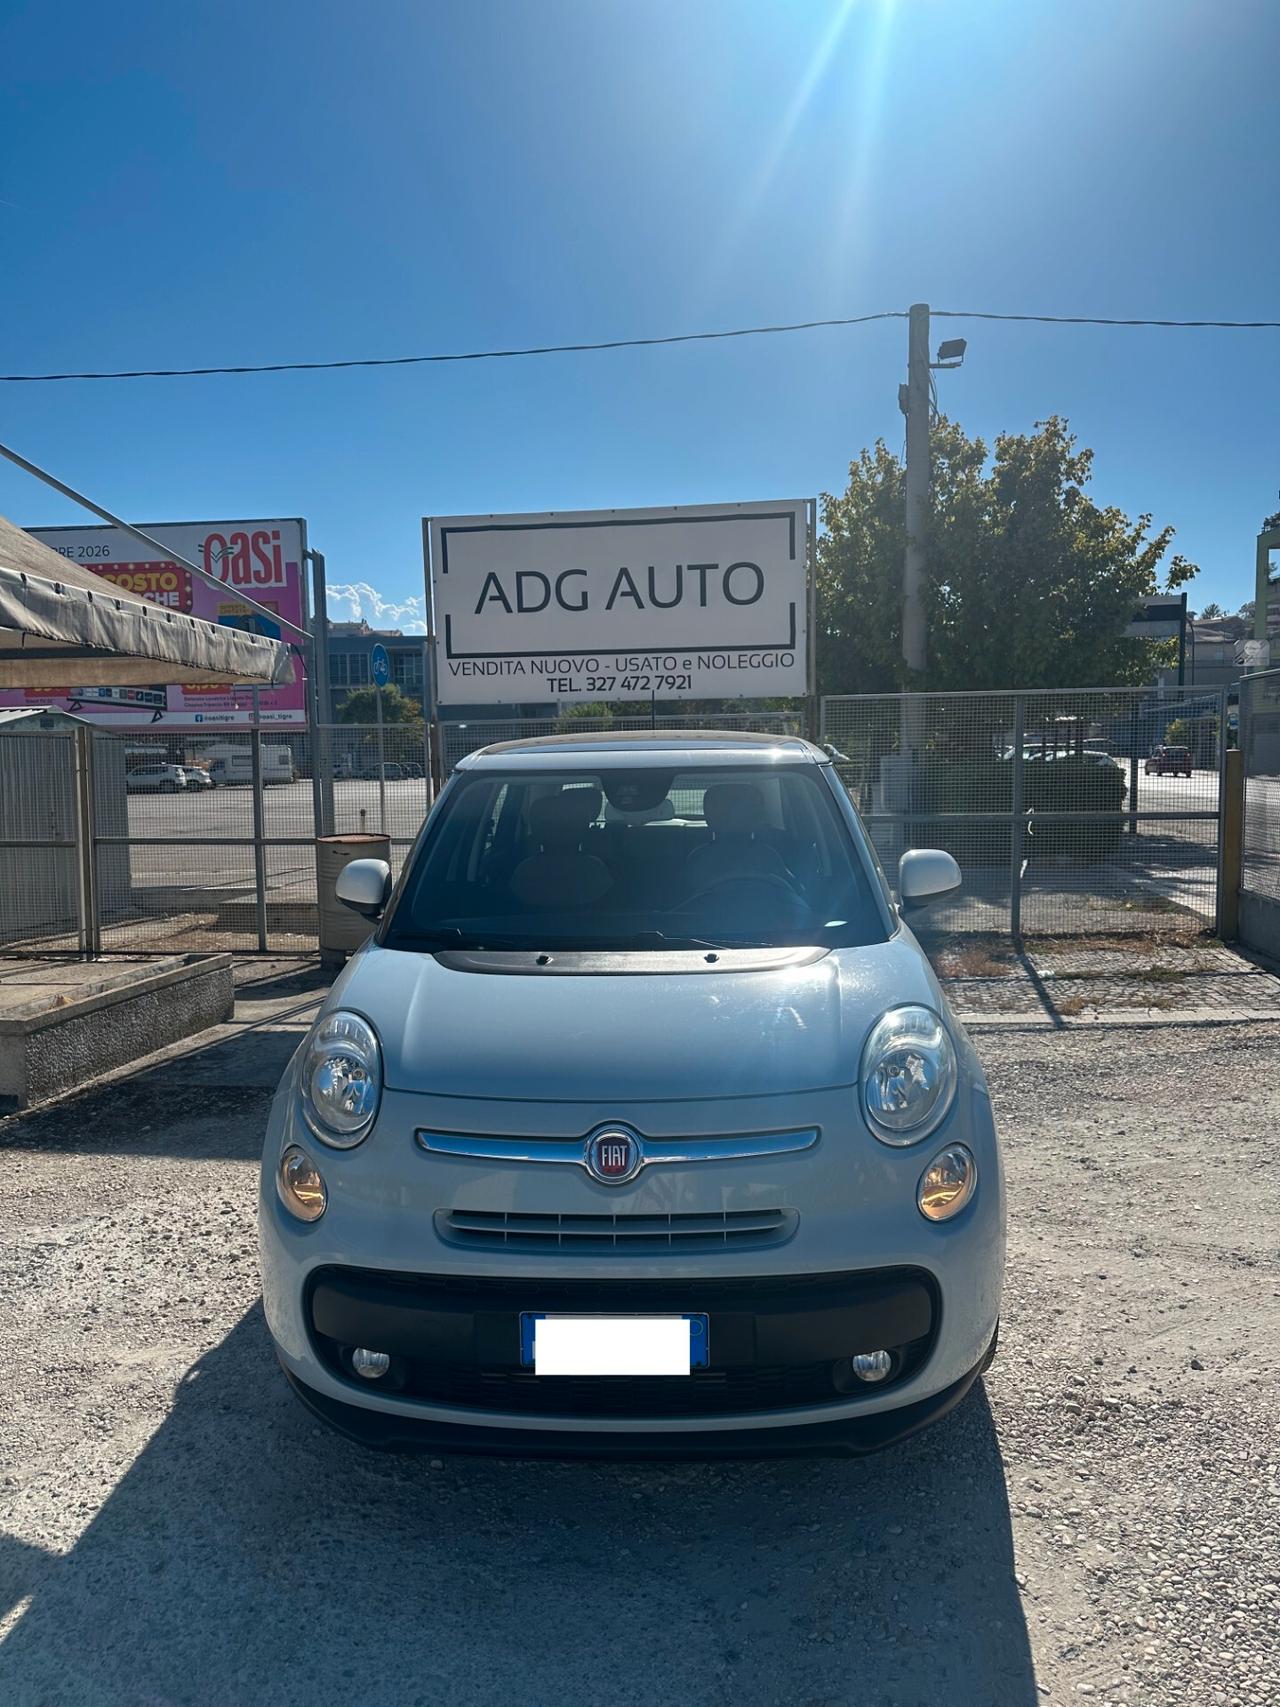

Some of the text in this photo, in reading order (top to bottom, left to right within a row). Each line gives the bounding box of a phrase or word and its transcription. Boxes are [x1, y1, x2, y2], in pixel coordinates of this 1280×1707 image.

[52, 545, 110, 557] RE 2026
[474, 561, 765, 615] ADG AUTO
[448, 660, 526, 676] VENDITA
[531, 658, 600, 675] NUOVO
[615, 656, 677, 672] USATO
[682, 659, 692, 670] e
[697, 652, 795, 670] NOLEGGIO
[546, 674, 692, 693] TEL. 327 472 7921
[602, 1145, 627, 1166] FIAT
